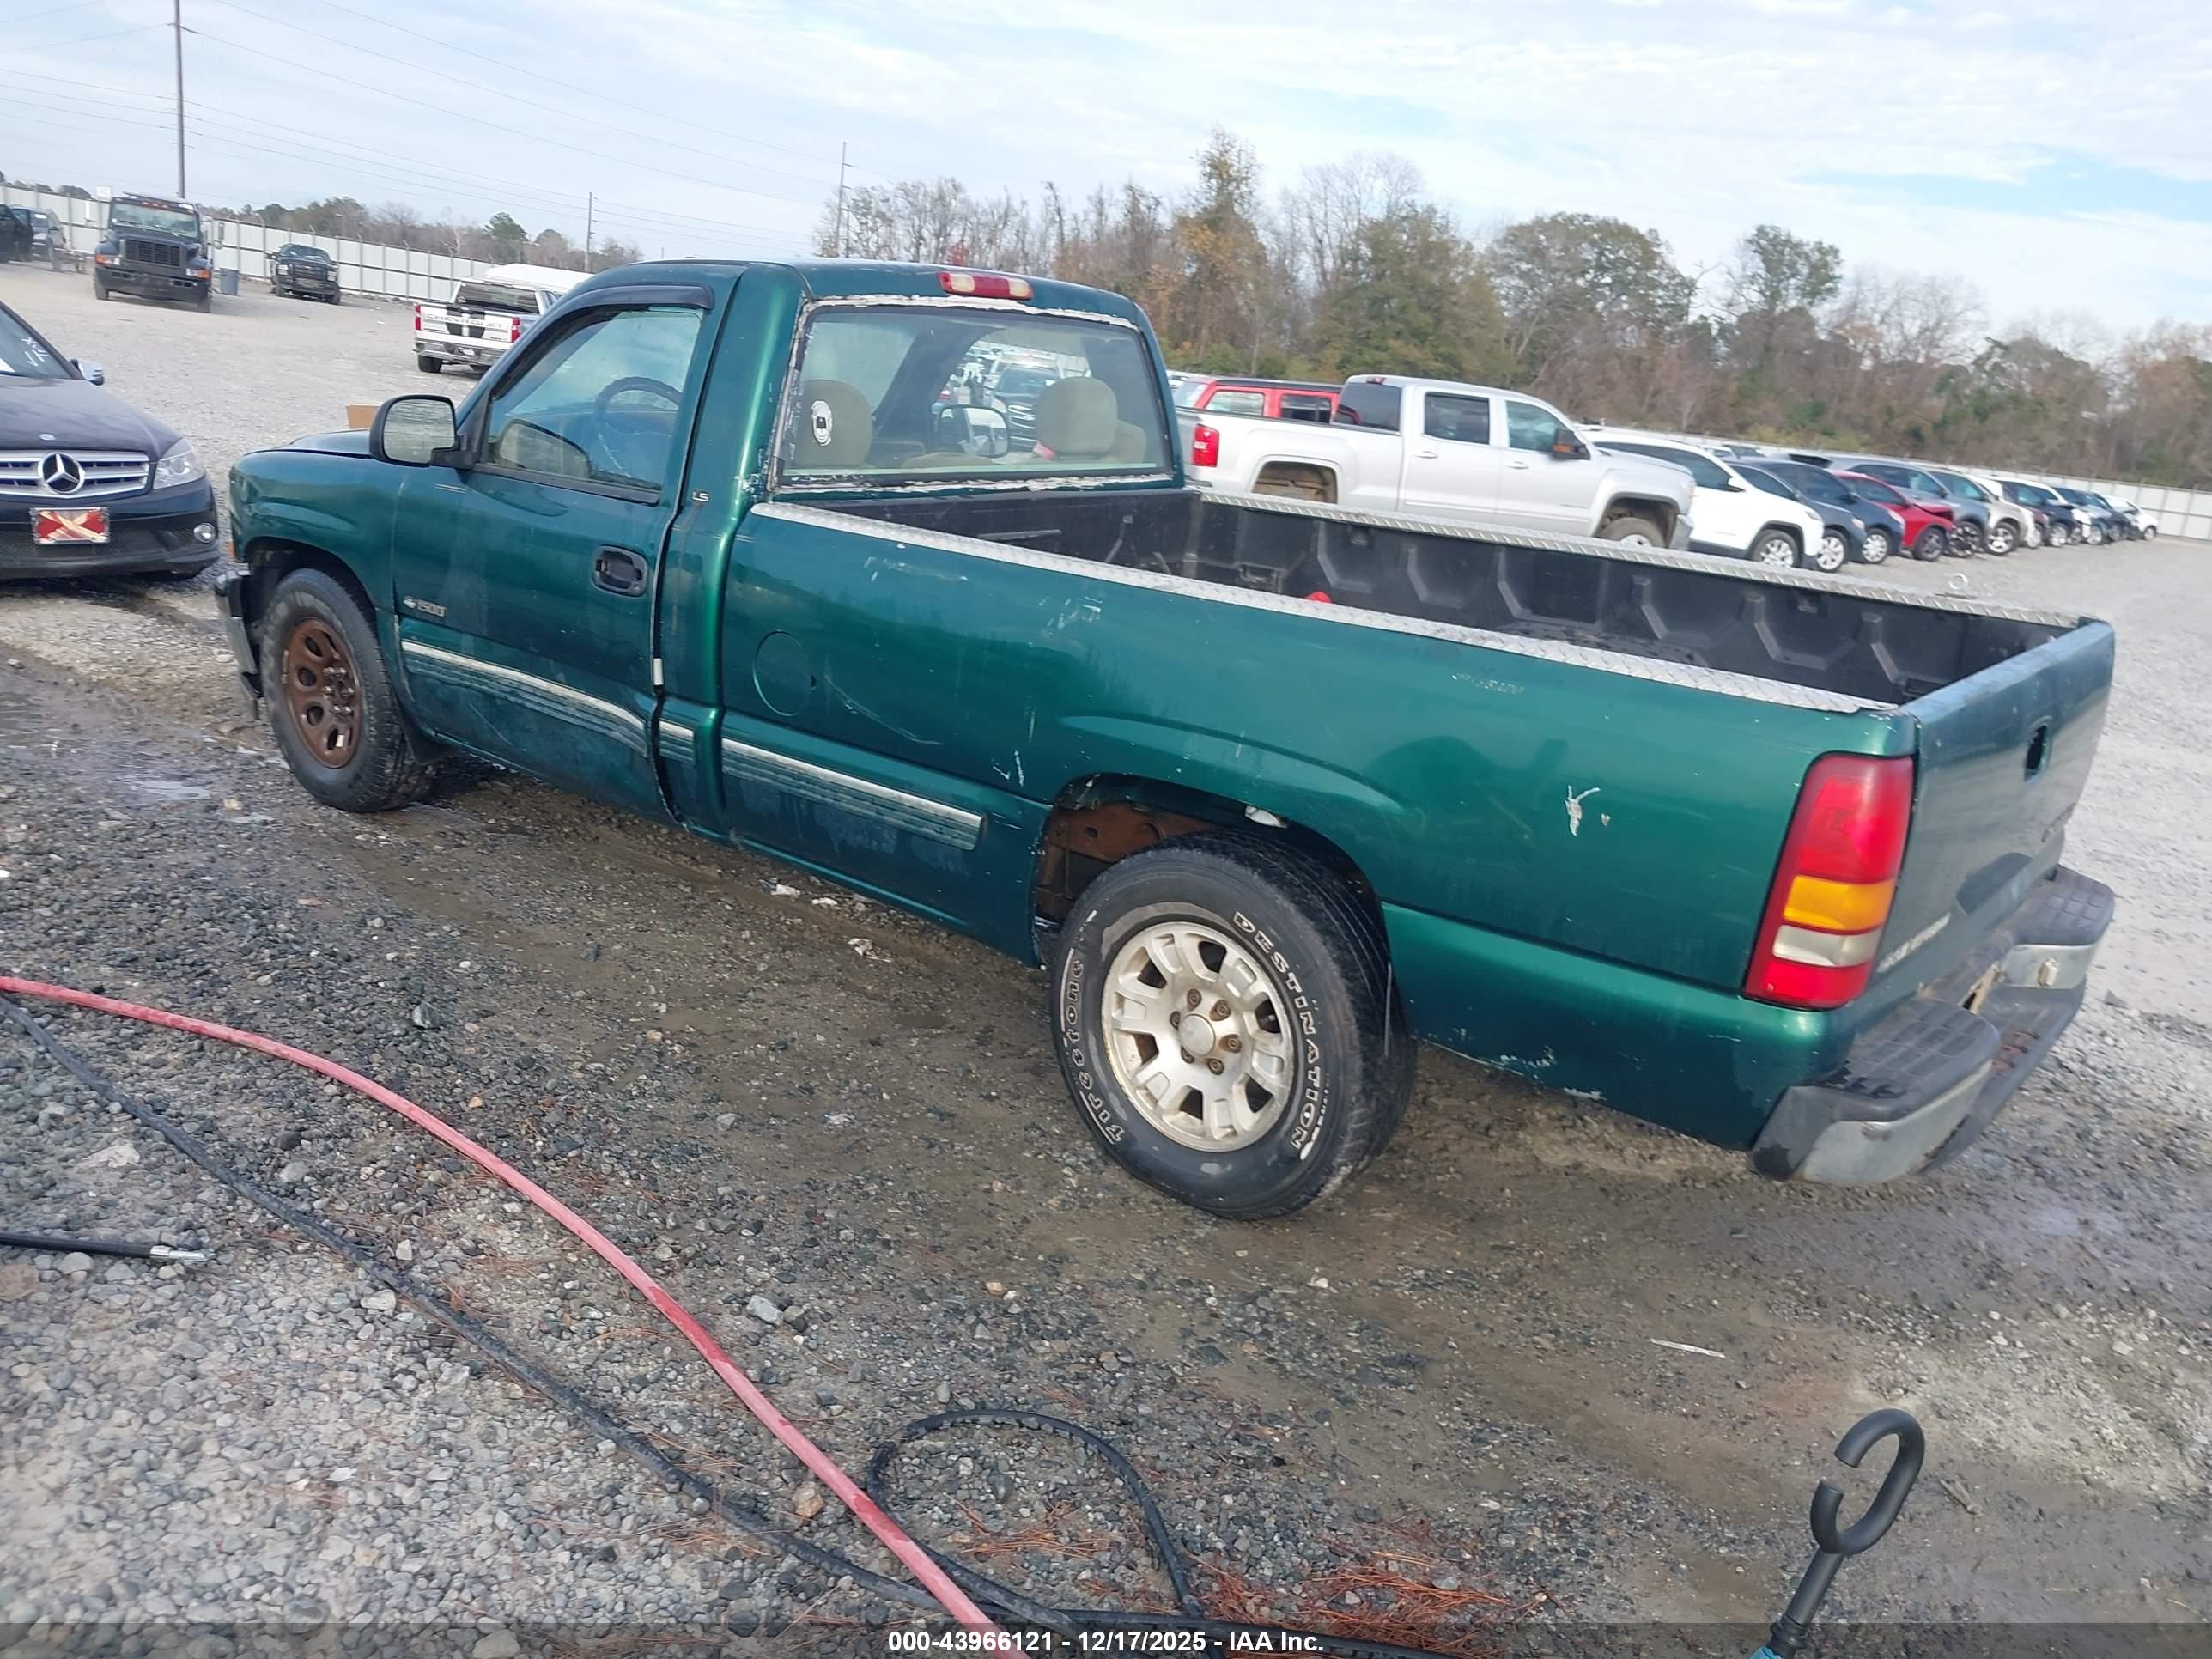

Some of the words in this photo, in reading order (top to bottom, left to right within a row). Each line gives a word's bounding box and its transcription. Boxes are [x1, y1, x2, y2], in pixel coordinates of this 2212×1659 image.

[426, 313, 502, 329] CHEVROLET
[692, 491, 709, 502] LS
[416, 599, 447, 617] 1500
[1233, 911, 1321, 1150] DESTINATION
[1066, 960, 1126, 1143] Firestone
